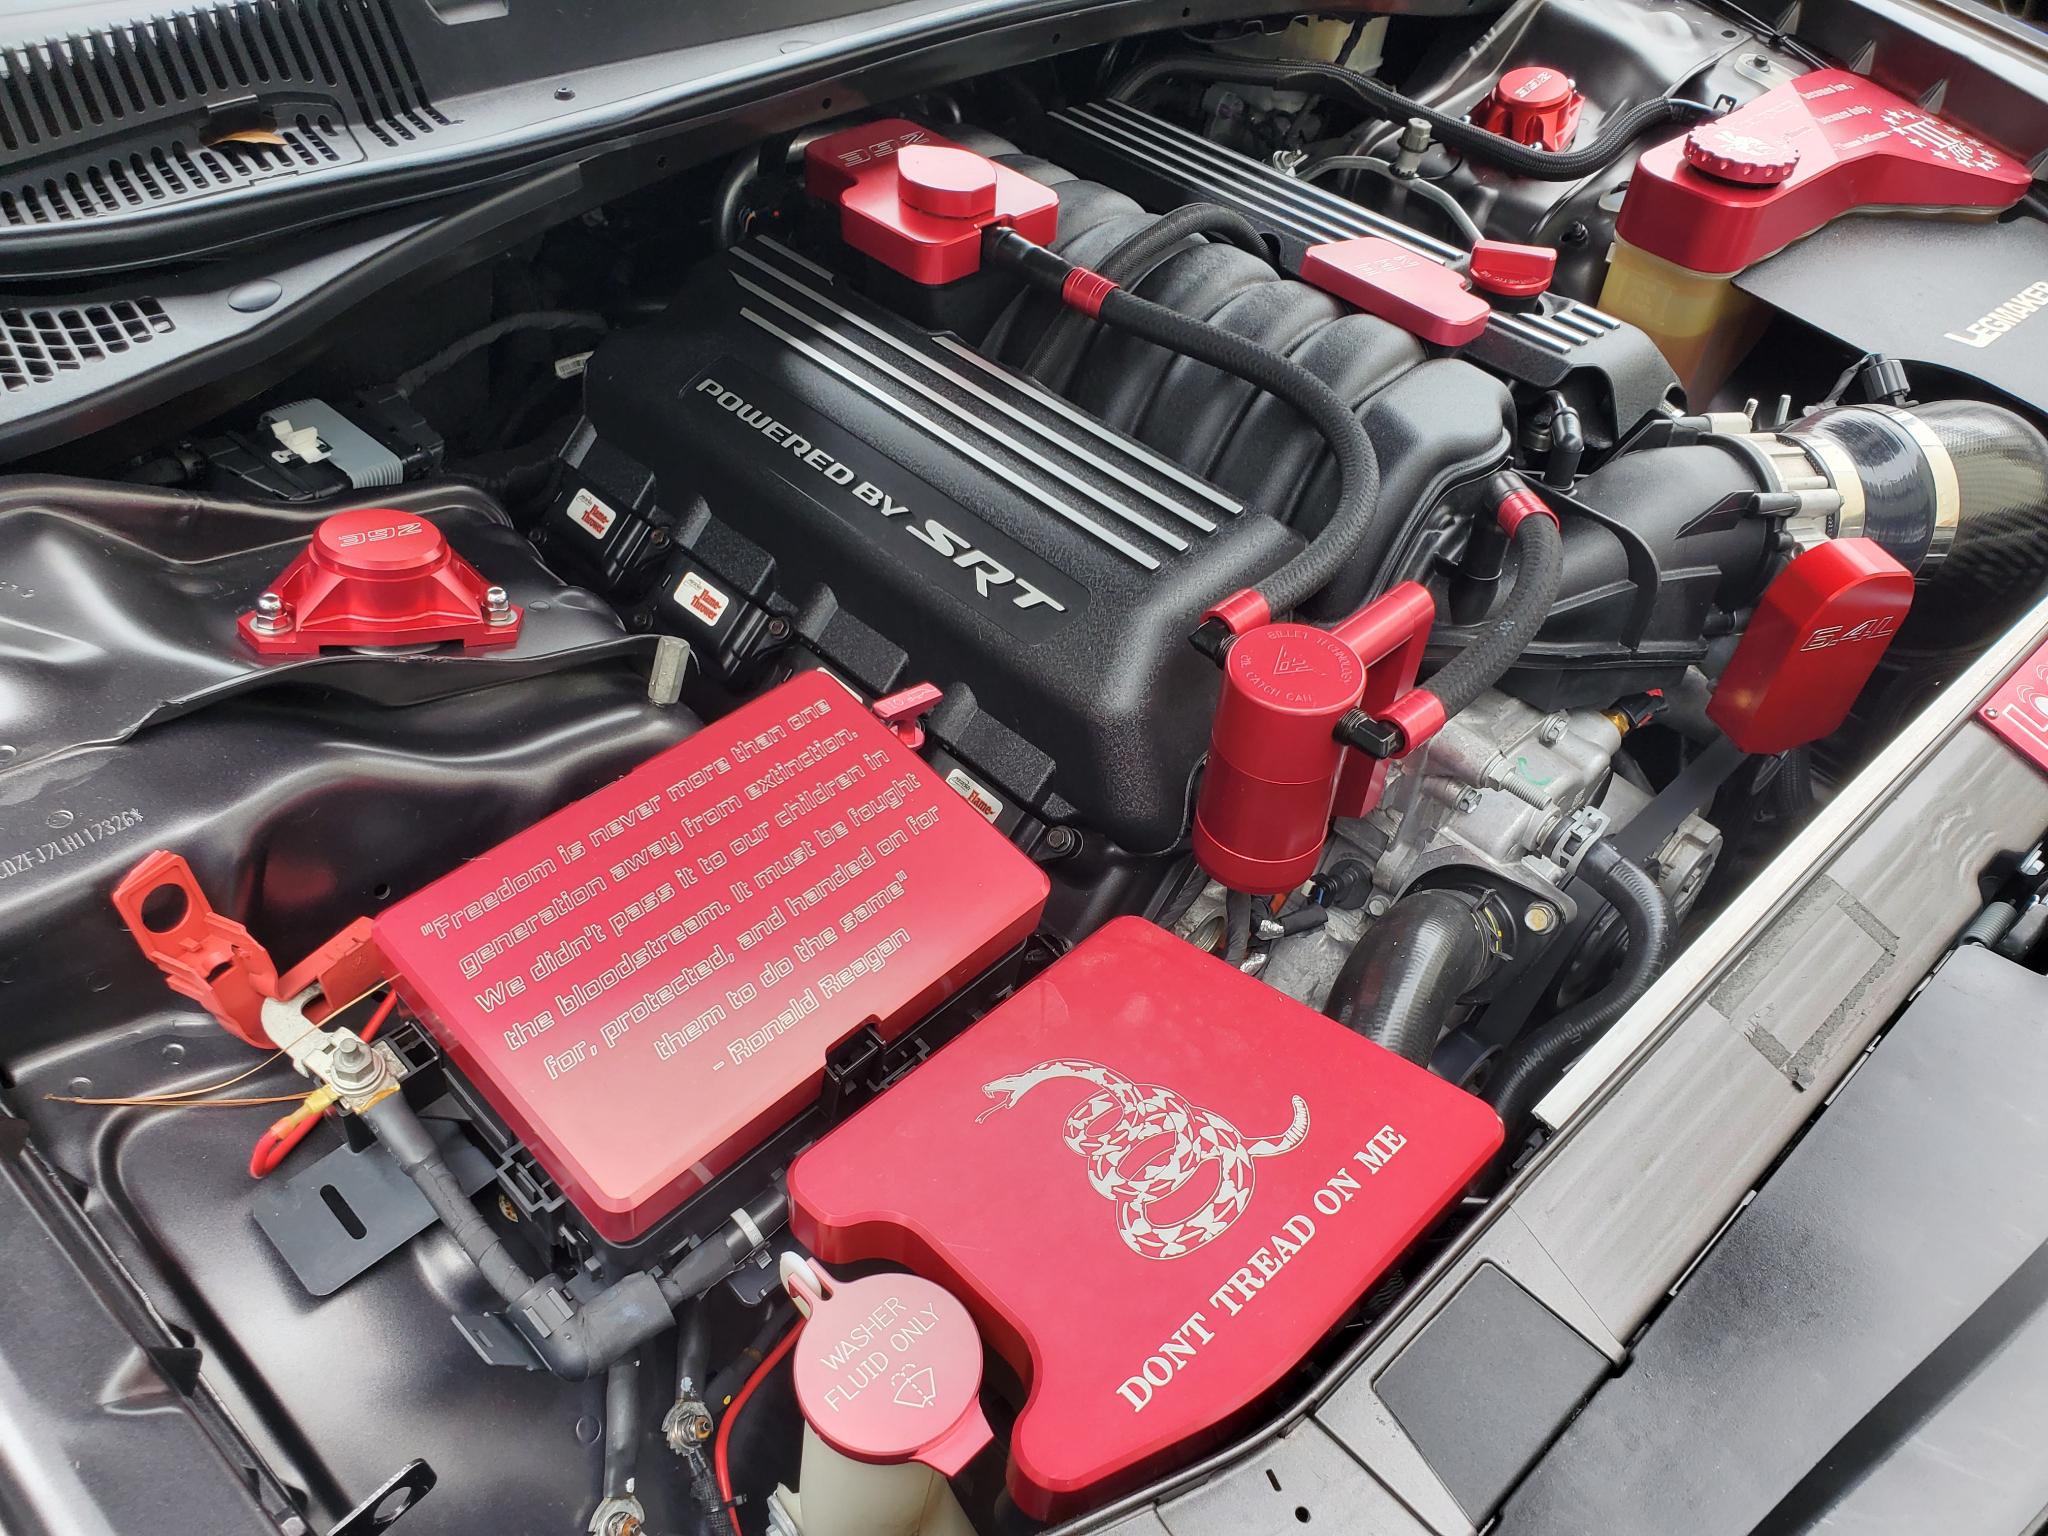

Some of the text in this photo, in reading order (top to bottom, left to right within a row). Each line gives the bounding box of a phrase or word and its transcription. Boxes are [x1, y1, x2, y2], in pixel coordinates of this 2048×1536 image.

[338, 522, 422, 547] 392
[695, 377, 1066, 612] POWERED BY SRT
[420, 699, 832, 940] "Freedom is never more than one
[458, 727, 859, 980] generation away from extinction.
[474, 748, 892, 1013] We didn't pass it to our children in
[503, 772, 922, 1052] the bloodstream. It must be fought
[968, 789, 996, 815] Flame-
[543, 804, 941, 1081] for, protected, and handed on for
[653, 870, 908, 1062] them to do the same"
[726, 988, 821, 1066] Ronald
[817, 926, 912, 1000] Reagan
[820, 1297, 907, 1371] WASHER
[823, 1302, 940, 1412] FLUID ONLY
[1115, 1124, 1408, 1413] DONT TREAD ON ME
